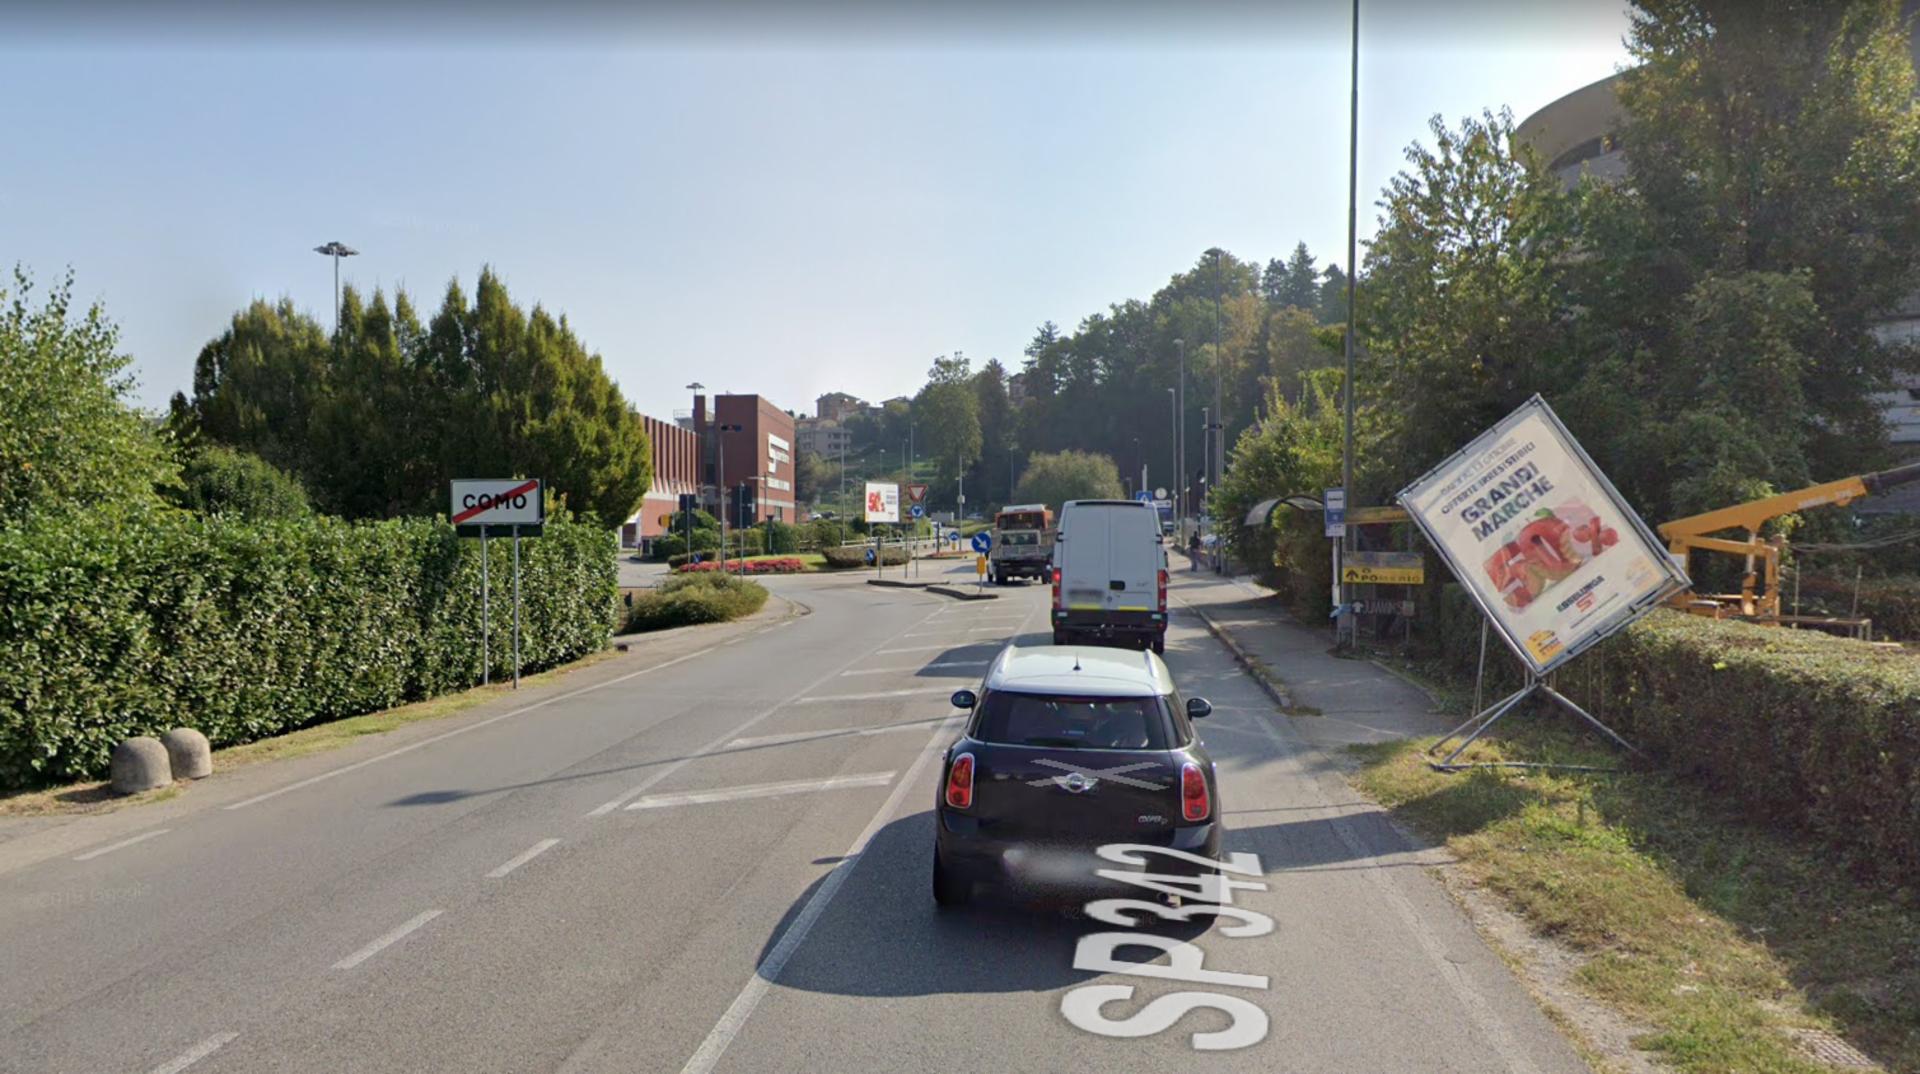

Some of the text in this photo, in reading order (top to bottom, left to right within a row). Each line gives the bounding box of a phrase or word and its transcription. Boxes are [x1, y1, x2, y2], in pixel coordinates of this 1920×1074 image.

[463, 493, 527, 510] COMO
[1461, 461, 1540, 524] GRANDI
[1472, 475, 1554, 542] MARCHE
[1483, 516, 1620, 609] 50%
